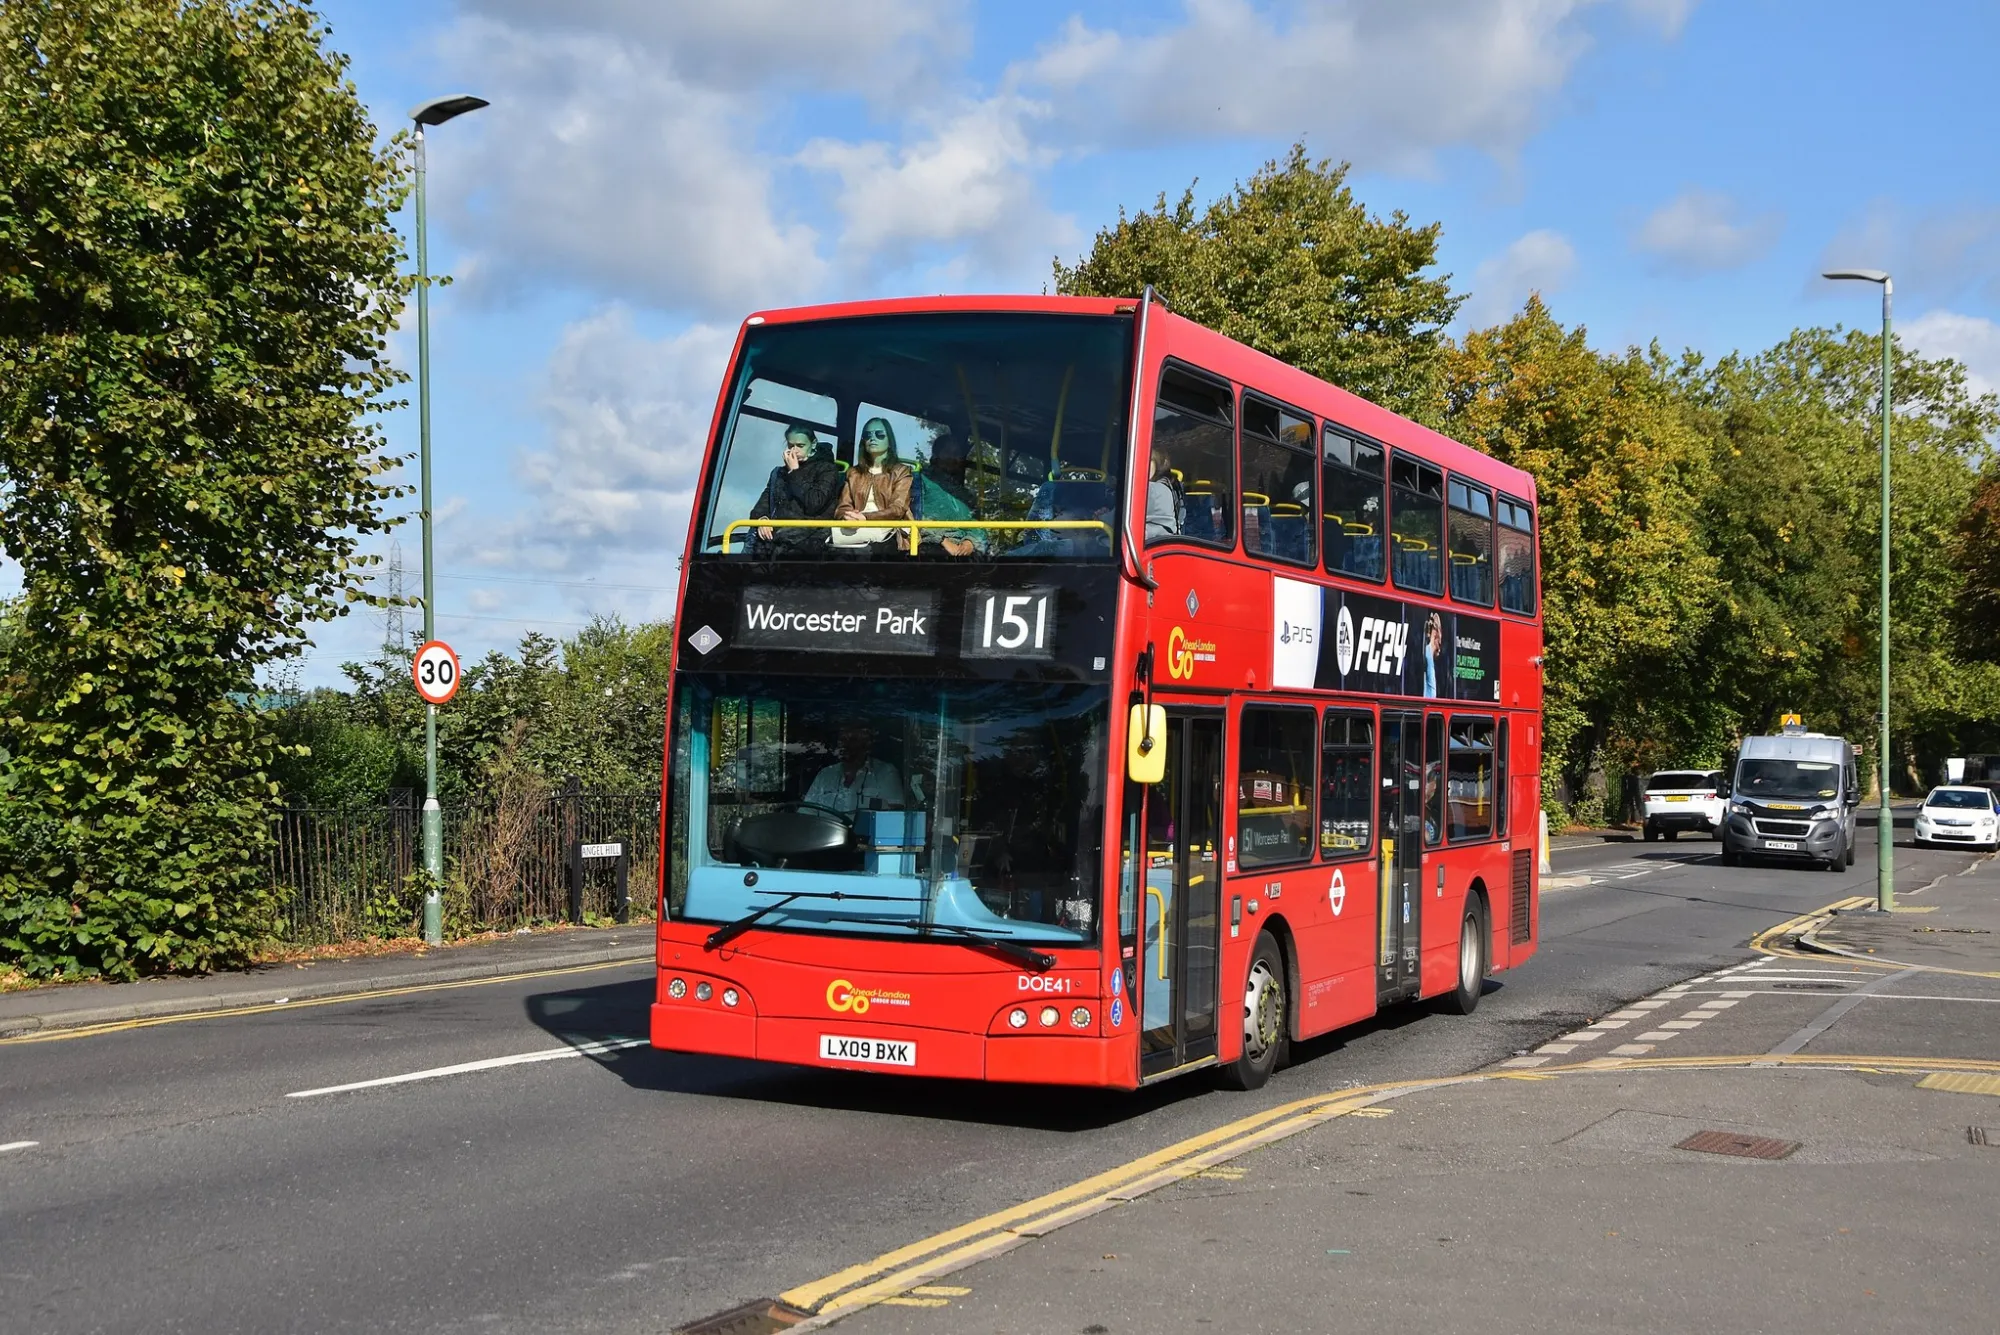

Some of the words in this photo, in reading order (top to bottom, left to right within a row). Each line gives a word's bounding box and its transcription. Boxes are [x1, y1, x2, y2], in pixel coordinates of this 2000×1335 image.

[746, 604, 866, 632] Worcester
[875, 607, 926, 635] Park
[982, 596, 1047, 649] 151
[1292, 625, 1313, 644] PS5
[1338, 621, 1351, 645] EA
[1168, 625, 1194, 680] Go
[1354, 616, 1409, 676] FC24
[420, 659, 453, 685] 30
[582, 845, 604, 856] ANGEL
[605, 844, 620, 855] HILL
[1254, 831, 1280, 847] Worcester
[850, 987, 911, 999] Ahead-London
[1018, 975, 1071, 993] DOE41
[826, 979, 870, 1014] Go
[827, 1038, 870, 1058] LX09
[875, 1042, 908, 1062] BXK
